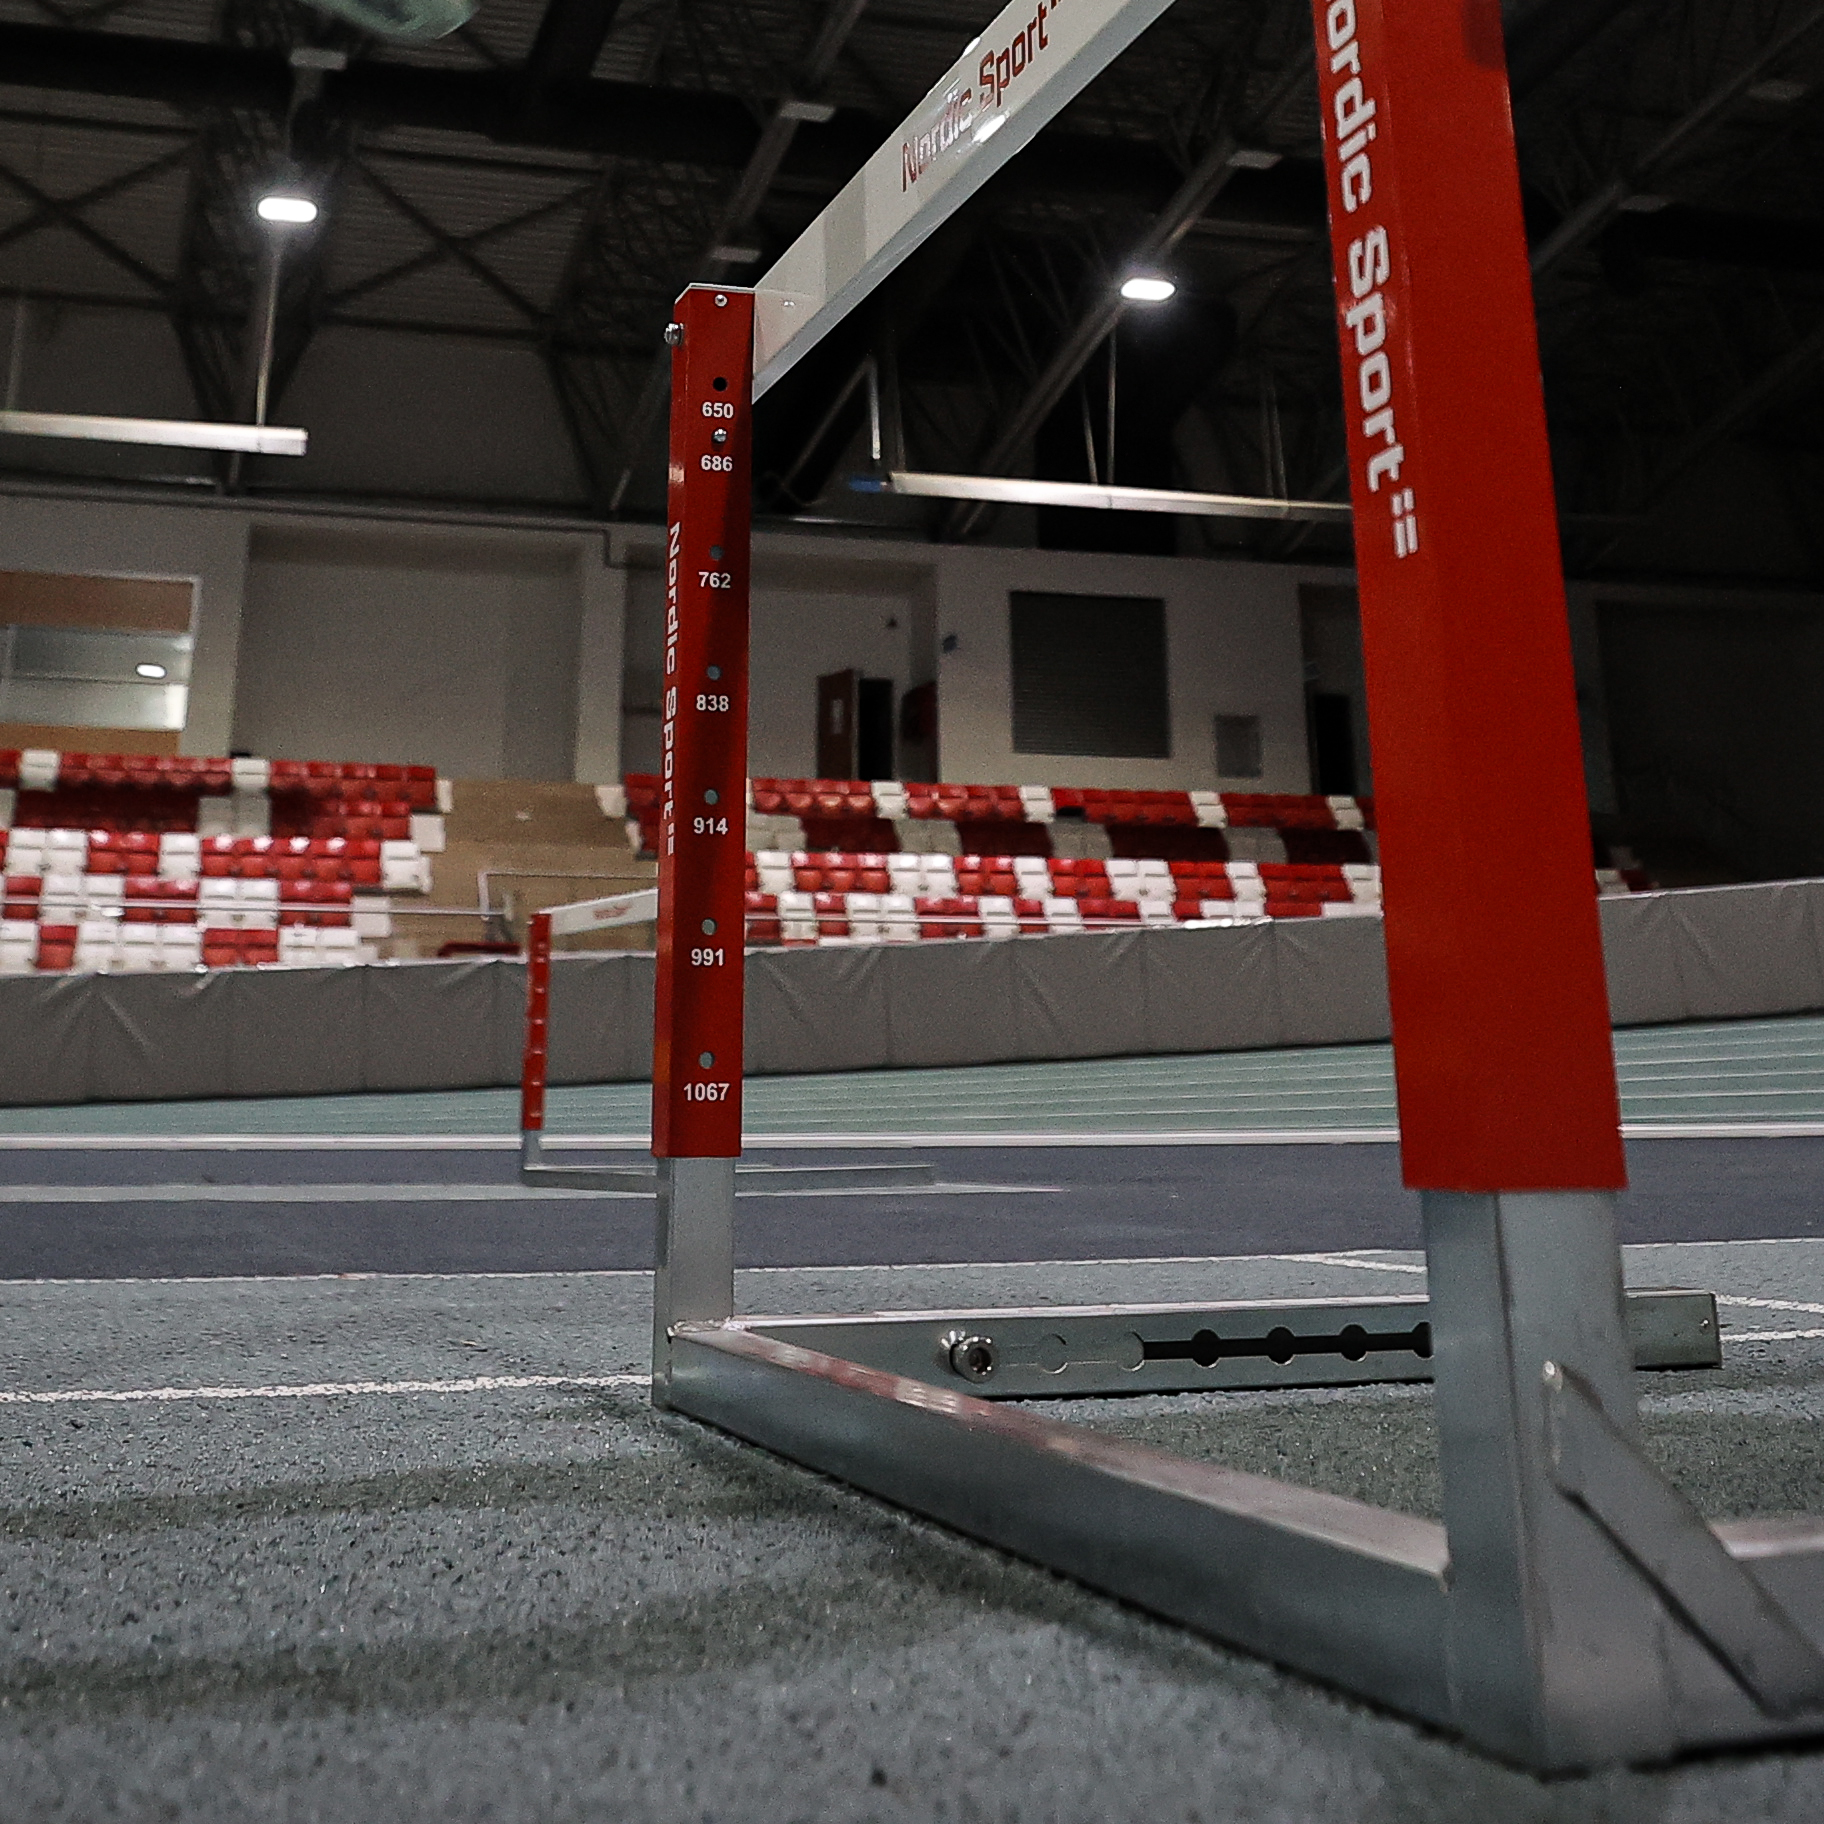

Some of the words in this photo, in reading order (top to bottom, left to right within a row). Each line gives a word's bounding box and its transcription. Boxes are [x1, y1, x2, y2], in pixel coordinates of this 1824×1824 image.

[979, 2, 1048, 108] Sport
[1344, 224, 1405, 493] Sport
[701, 401, 735, 419] 650
[700, 454, 734, 472] 686
[698, 571, 732, 589] 762
[665, 521, 681, 675] Nordic
[695, 694, 730, 712] 838
[663, 685, 677, 820] Sport
[693, 816, 729, 835] 914
[690, 947, 725, 966] 991
[683, 1082, 731, 1102] 1067
